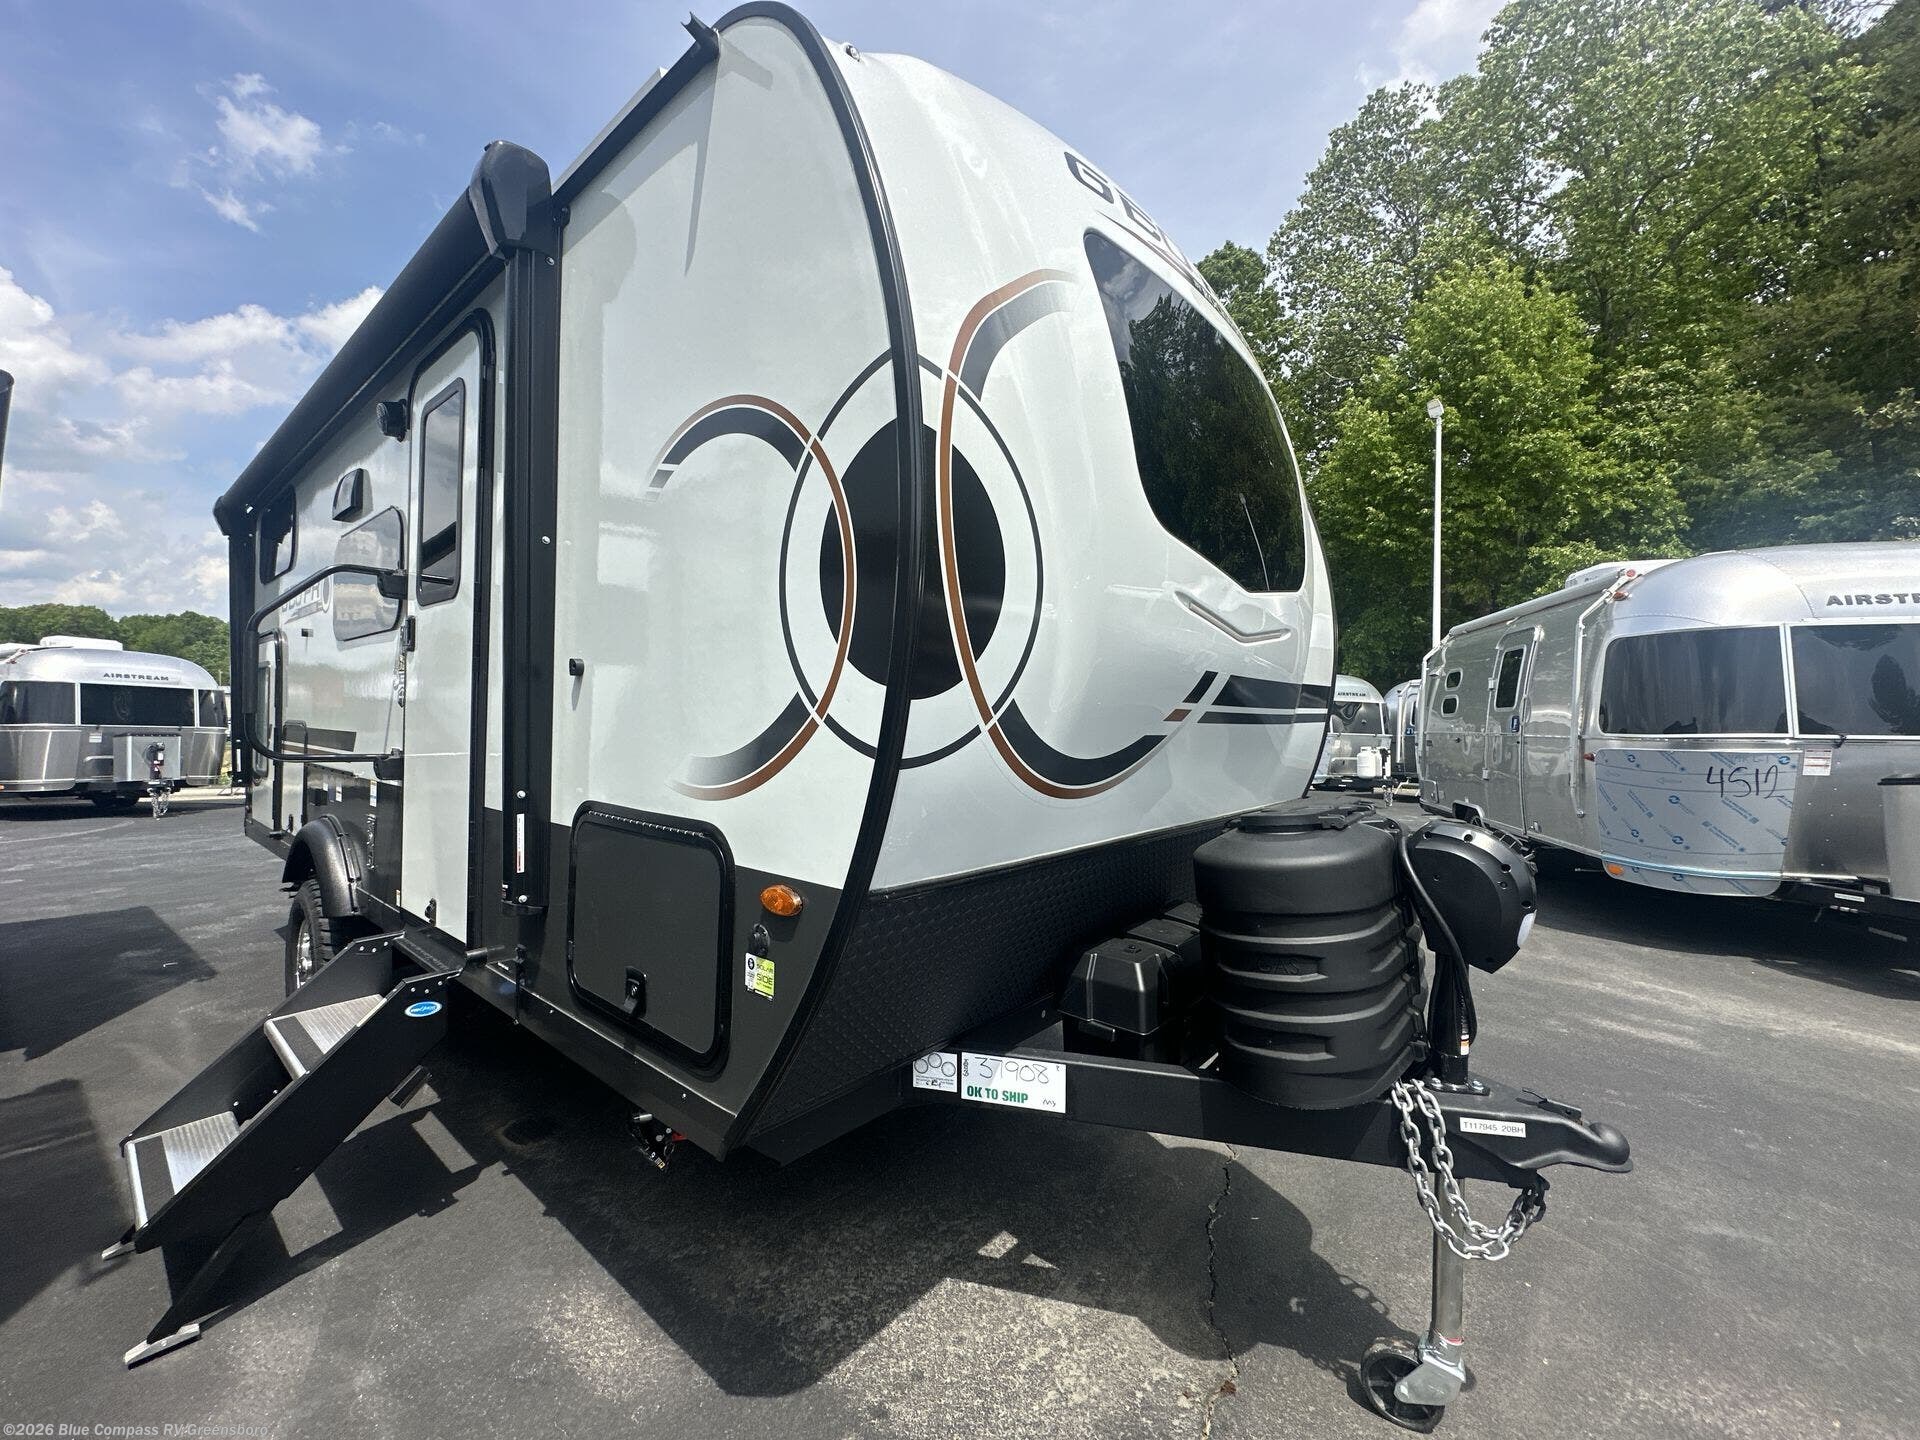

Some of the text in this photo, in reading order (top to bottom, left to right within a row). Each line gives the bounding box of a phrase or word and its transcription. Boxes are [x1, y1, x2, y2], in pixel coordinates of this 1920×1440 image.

[103, 672, 169, 681] AIRSTREAM
[1706, 764, 1785, 800] 4512
[967, 1085, 1029, 1104] OK TO SHIP
[1501, 1125, 1524, 1134] 20BH
